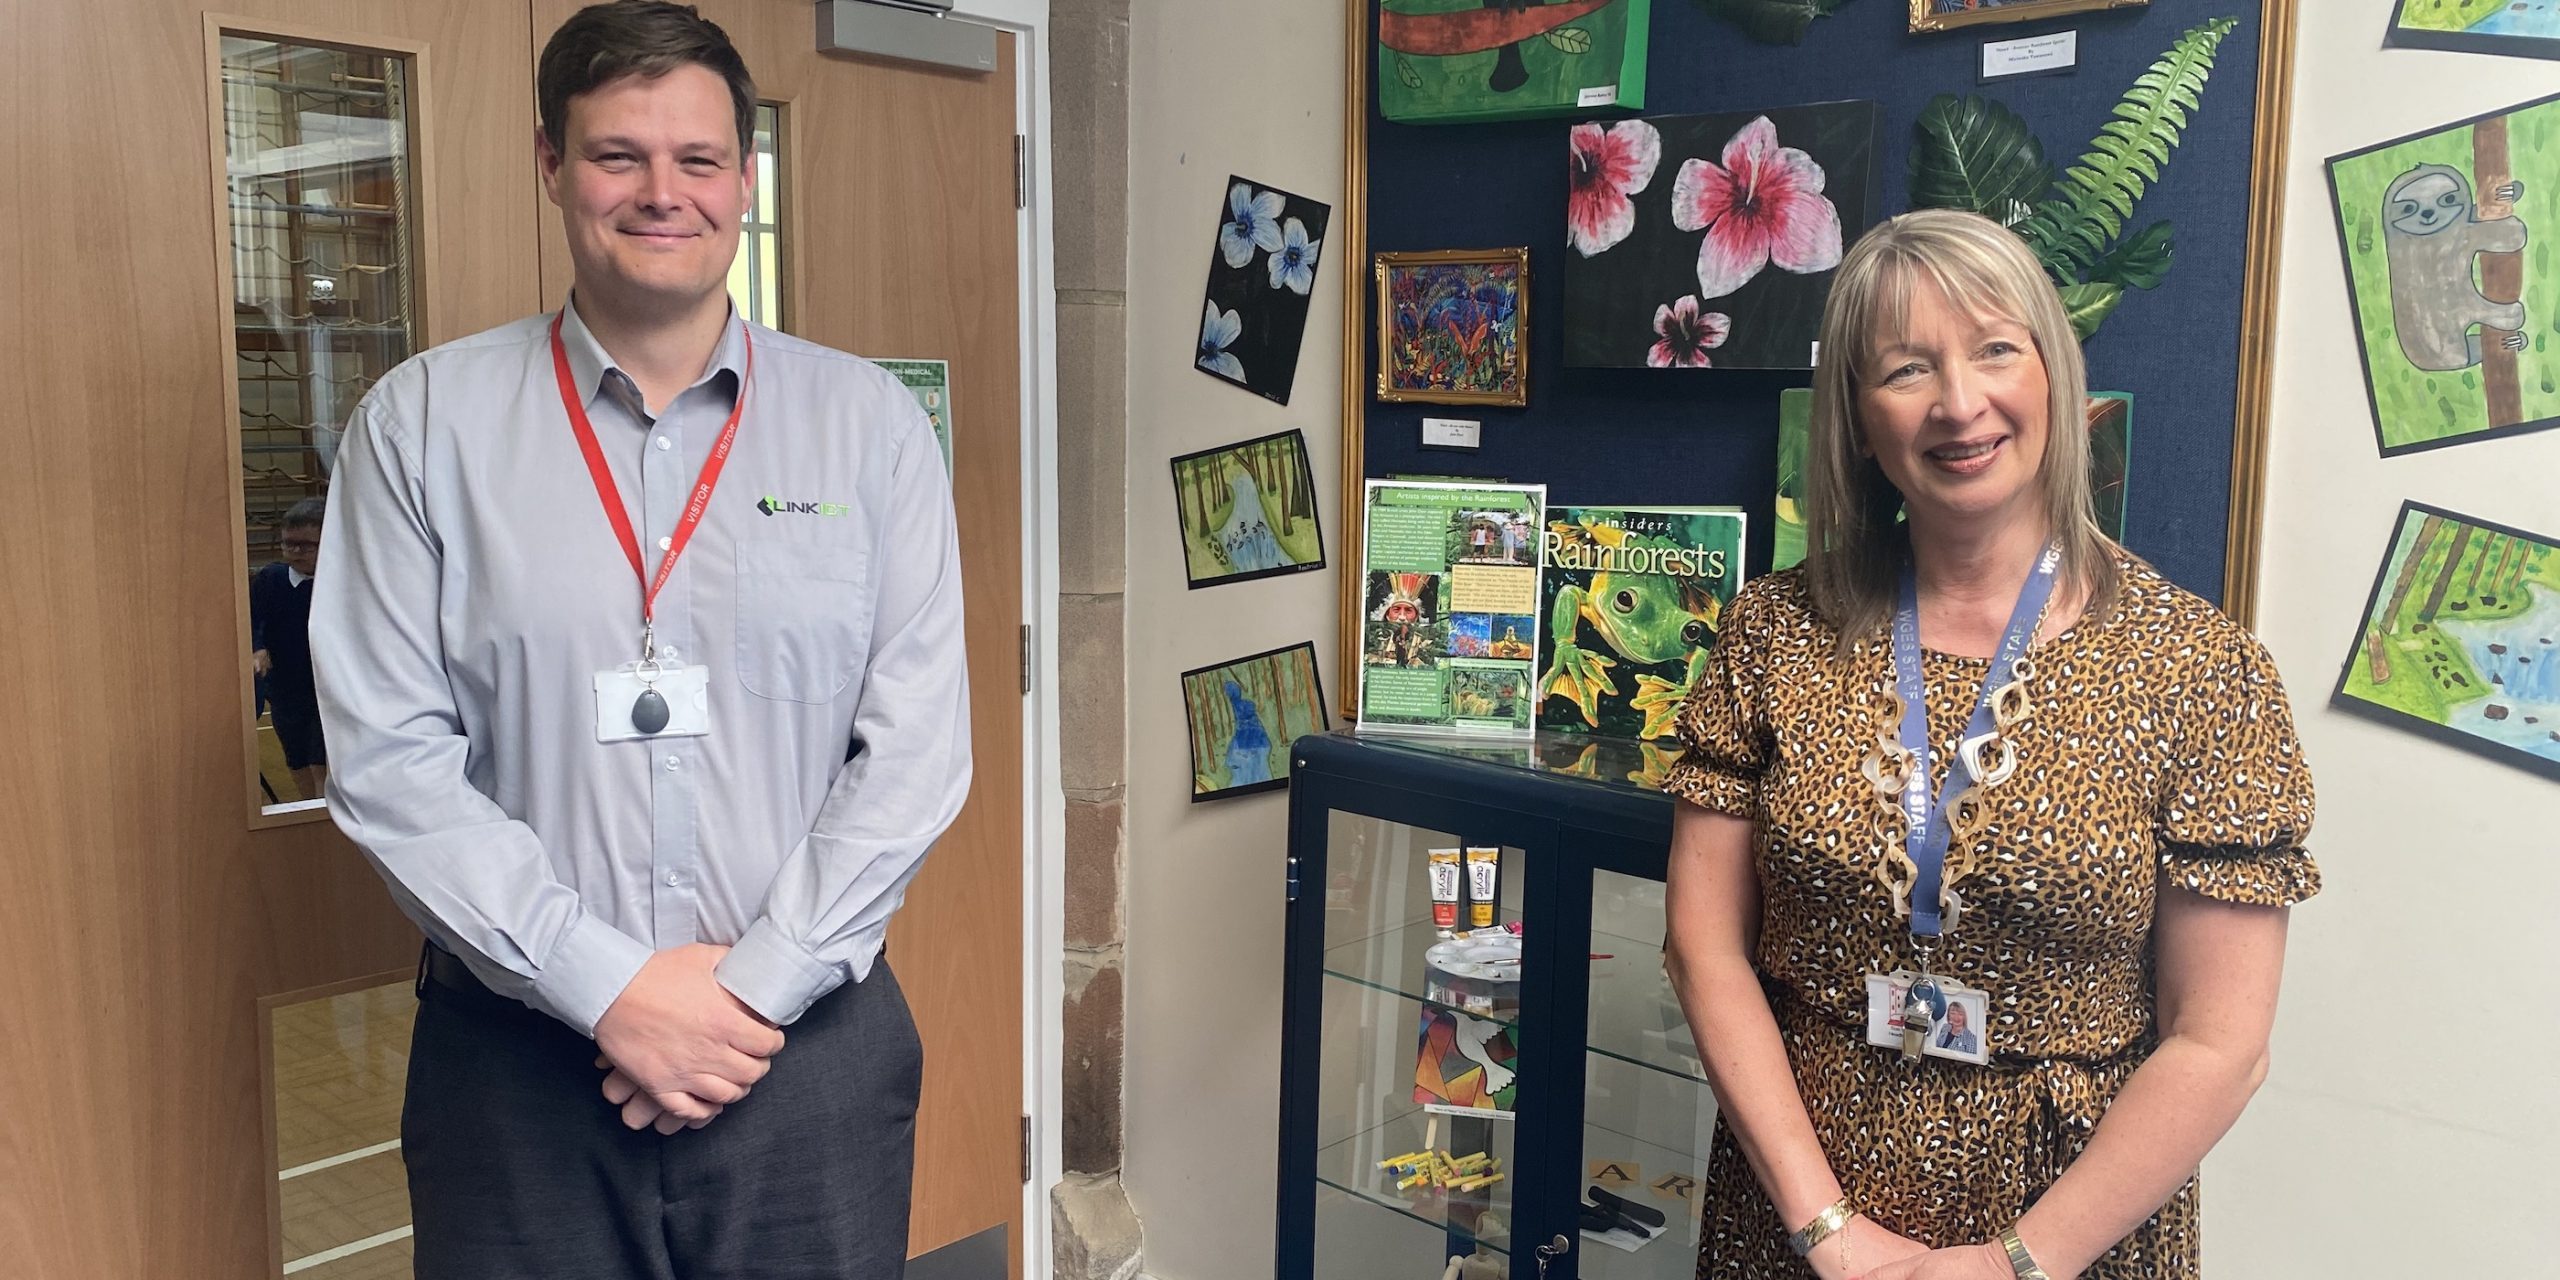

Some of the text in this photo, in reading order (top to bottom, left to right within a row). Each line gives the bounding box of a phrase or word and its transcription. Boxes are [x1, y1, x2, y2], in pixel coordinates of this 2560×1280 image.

[715, 423, 736, 460] VISITOR
[687, 483, 710, 524] VISITOR
[1396, 492, 1511, 503] Artists inspired by the Rainforest
[1604, 516, 1673, 531] insiders
[655, 551, 678, 591] VISITOR
[1541, 531, 1726, 579] Rainforests
[1900, 609, 1919, 700] WGES STAFF
[1910, 794, 1927, 845] STAFF
[1437, 866, 1447, 898] acrylic
[1474, 865, 1485, 898] acrylic
[1592, 1164, 1697, 1199] A R
